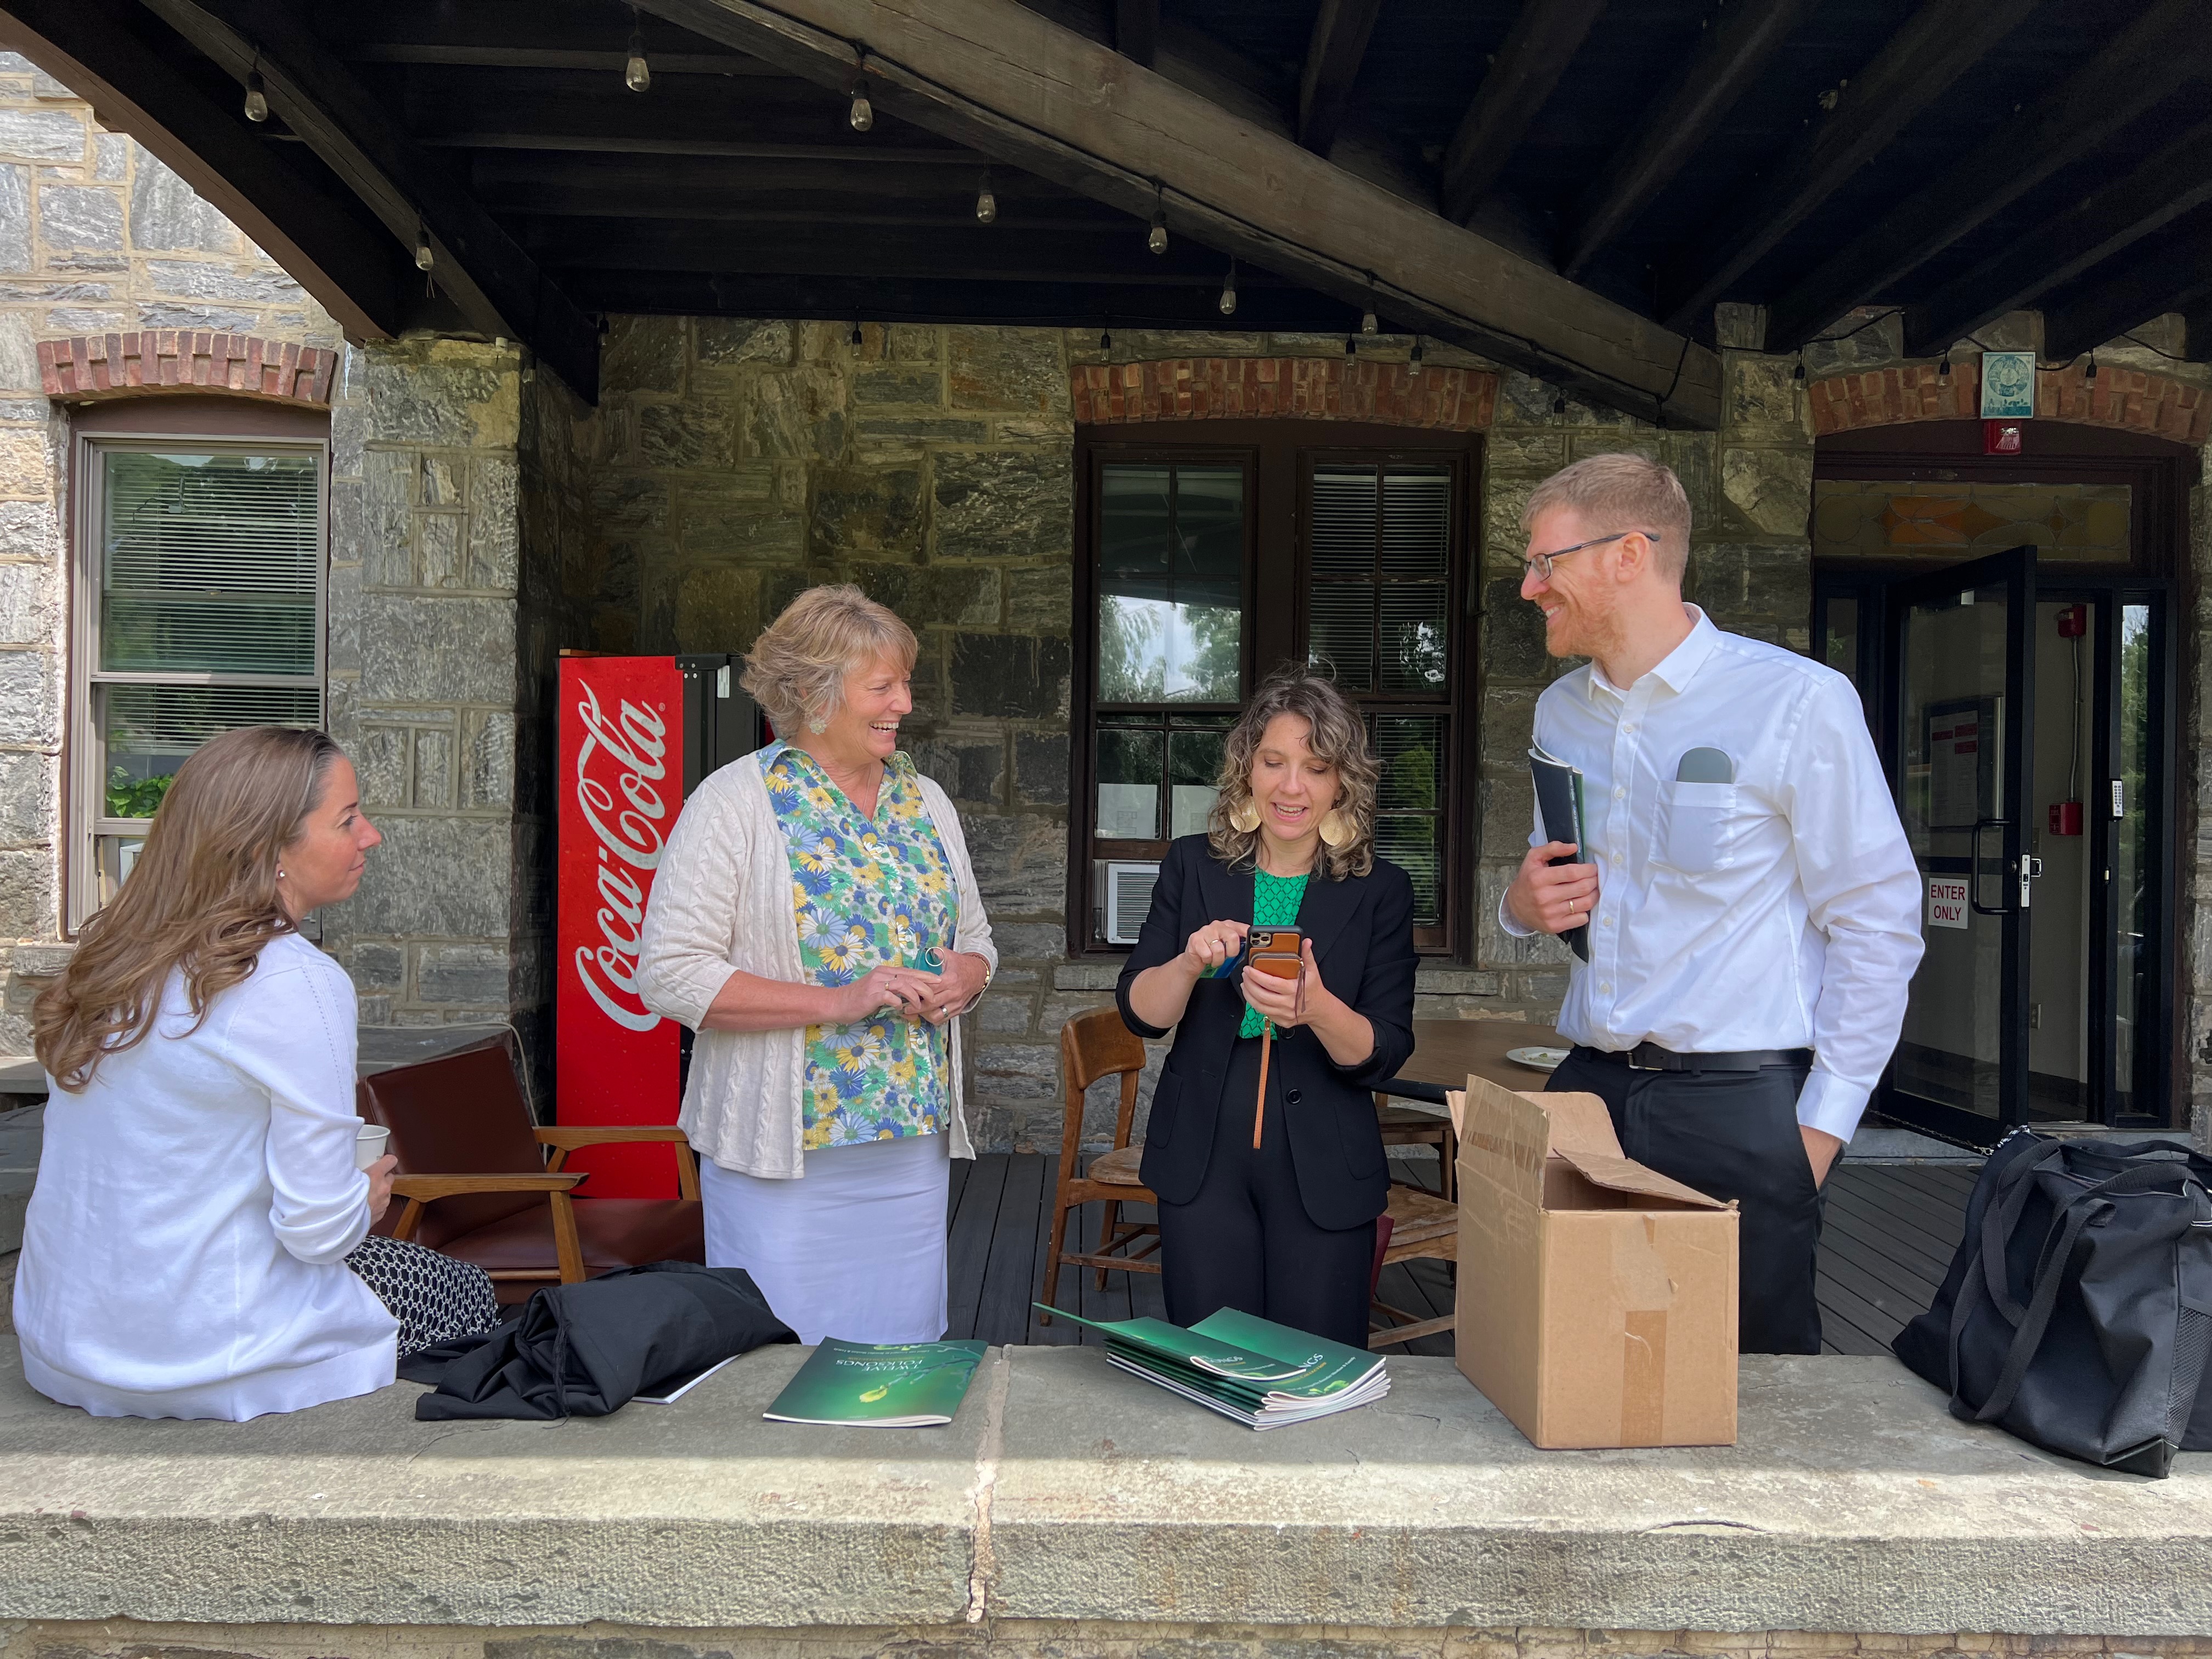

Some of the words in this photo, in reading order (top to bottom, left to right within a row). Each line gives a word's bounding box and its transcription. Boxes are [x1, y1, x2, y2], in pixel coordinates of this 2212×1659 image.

[575, 678, 665, 1031] Coca-Cola
[1931, 884, 1965, 900] ENTER
[1934, 905, 1962, 921] ONLY
[835, 1359, 923, 1367] FOLKSONGS
